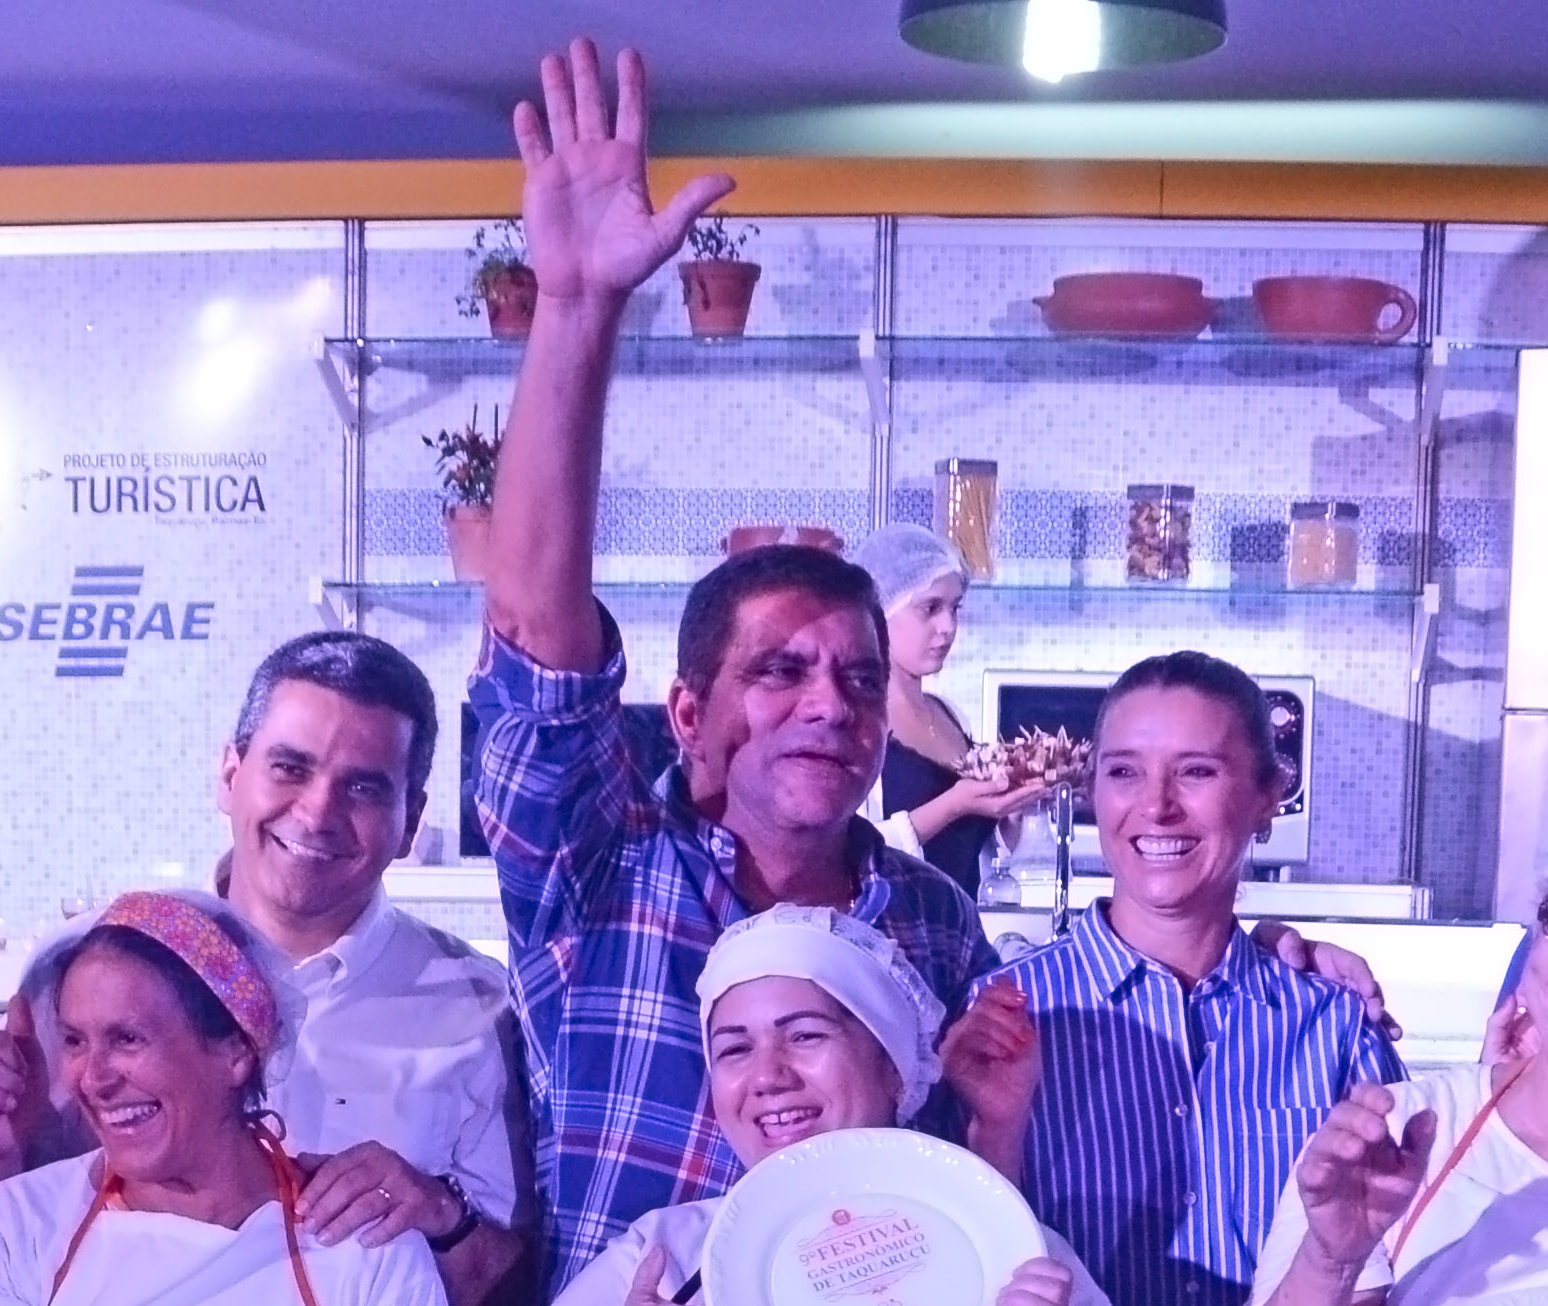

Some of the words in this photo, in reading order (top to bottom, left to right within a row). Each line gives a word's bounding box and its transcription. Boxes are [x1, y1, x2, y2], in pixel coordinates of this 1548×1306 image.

[63, 453, 125, 468] PROJETO
[131, 453, 149, 468] DE
[154, 451, 267, 470] ESTRUTURAÇÃO
[64, 467, 267, 513] TURÍSTICA
[816, 1218, 919, 1261] FESTIVAL
[812, 1278, 835, 1292] DE
[838, 1244, 931, 1283] TAQUARUÇU
